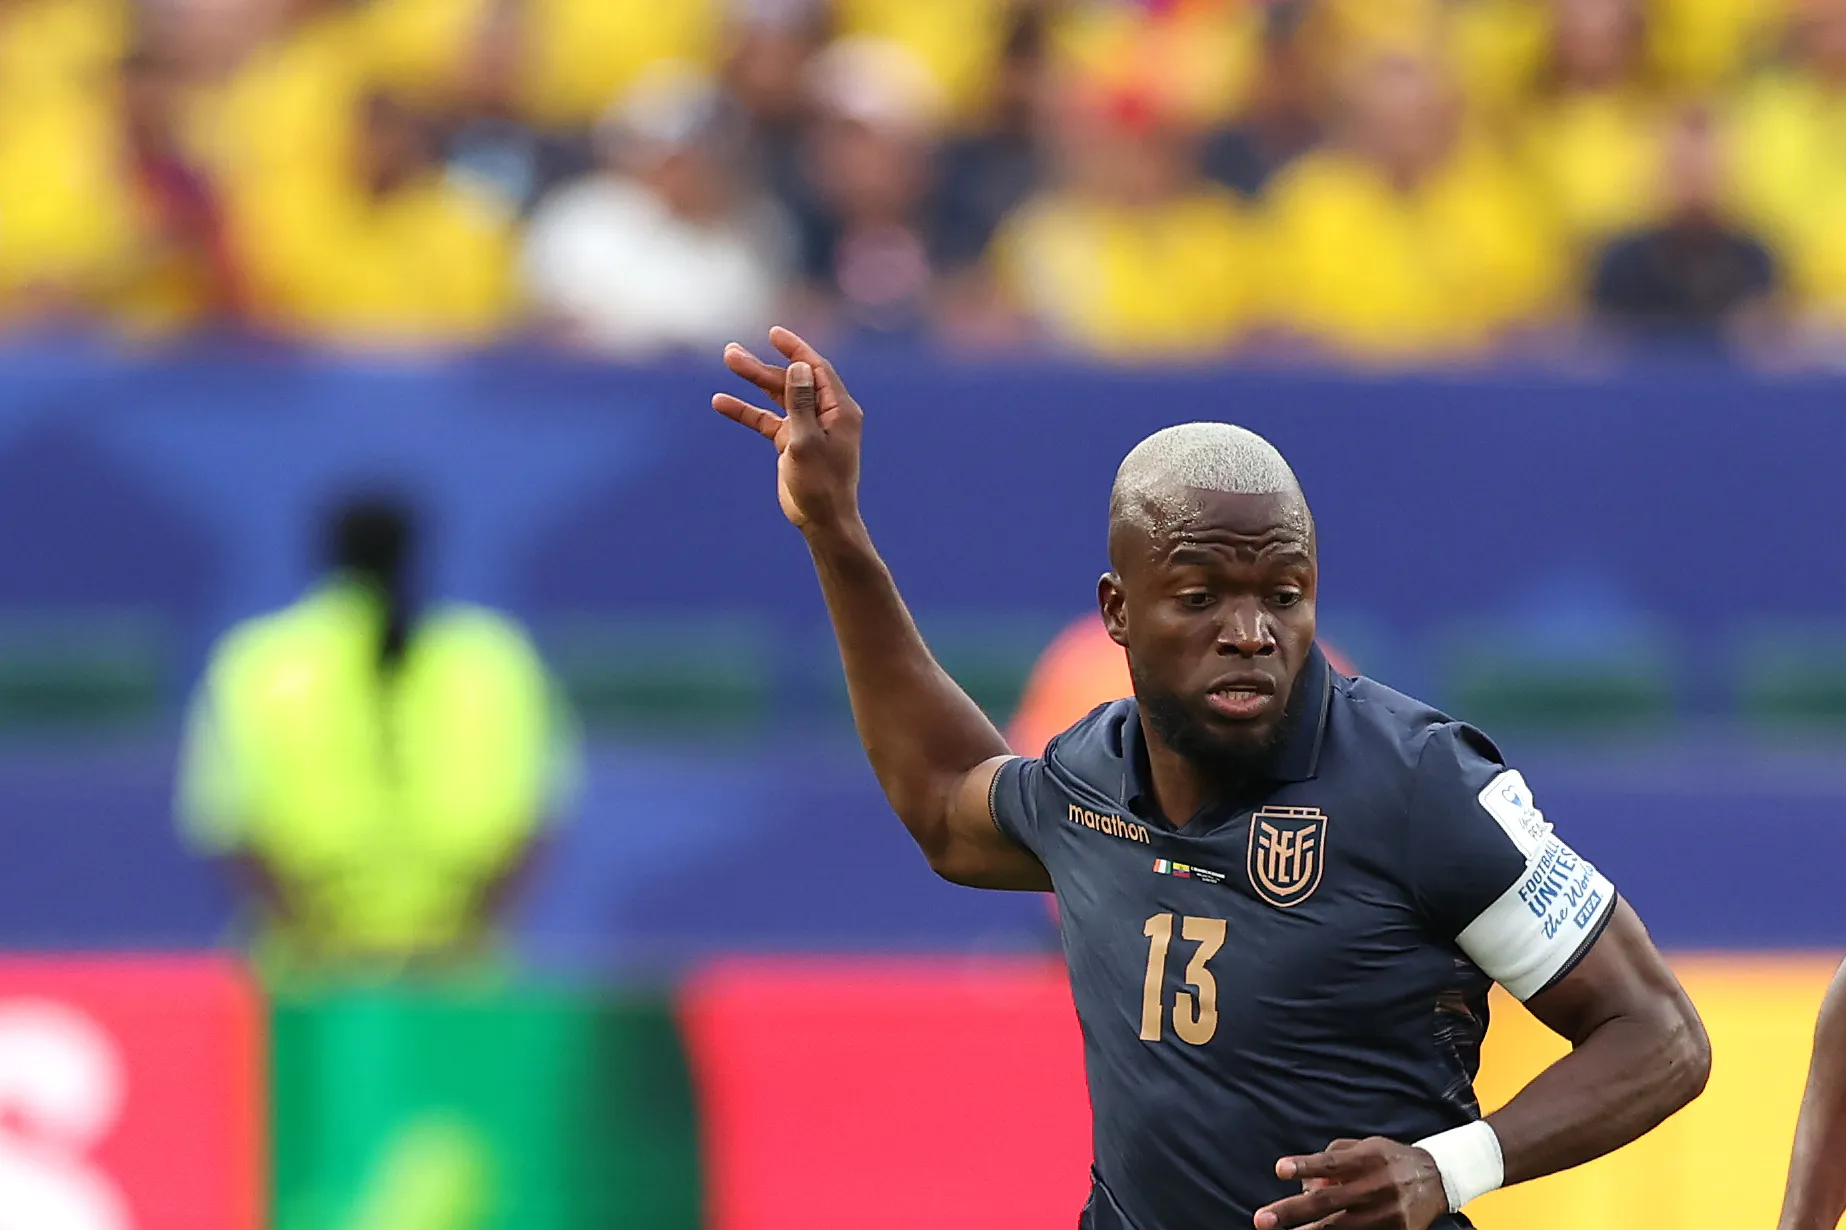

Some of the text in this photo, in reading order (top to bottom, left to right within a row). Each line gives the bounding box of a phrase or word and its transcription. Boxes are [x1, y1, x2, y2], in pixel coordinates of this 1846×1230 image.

[1068, 803, 1150, 844] marathon
[1518, 840, 1559, 902] FOOTBALL
[1528, 848, 1578, 918] UNITES
[1541, 906, 1569, 939] the
[1574, 890, 1602, 929] FIFA
[1139, 913, 1228, 1046] 13
